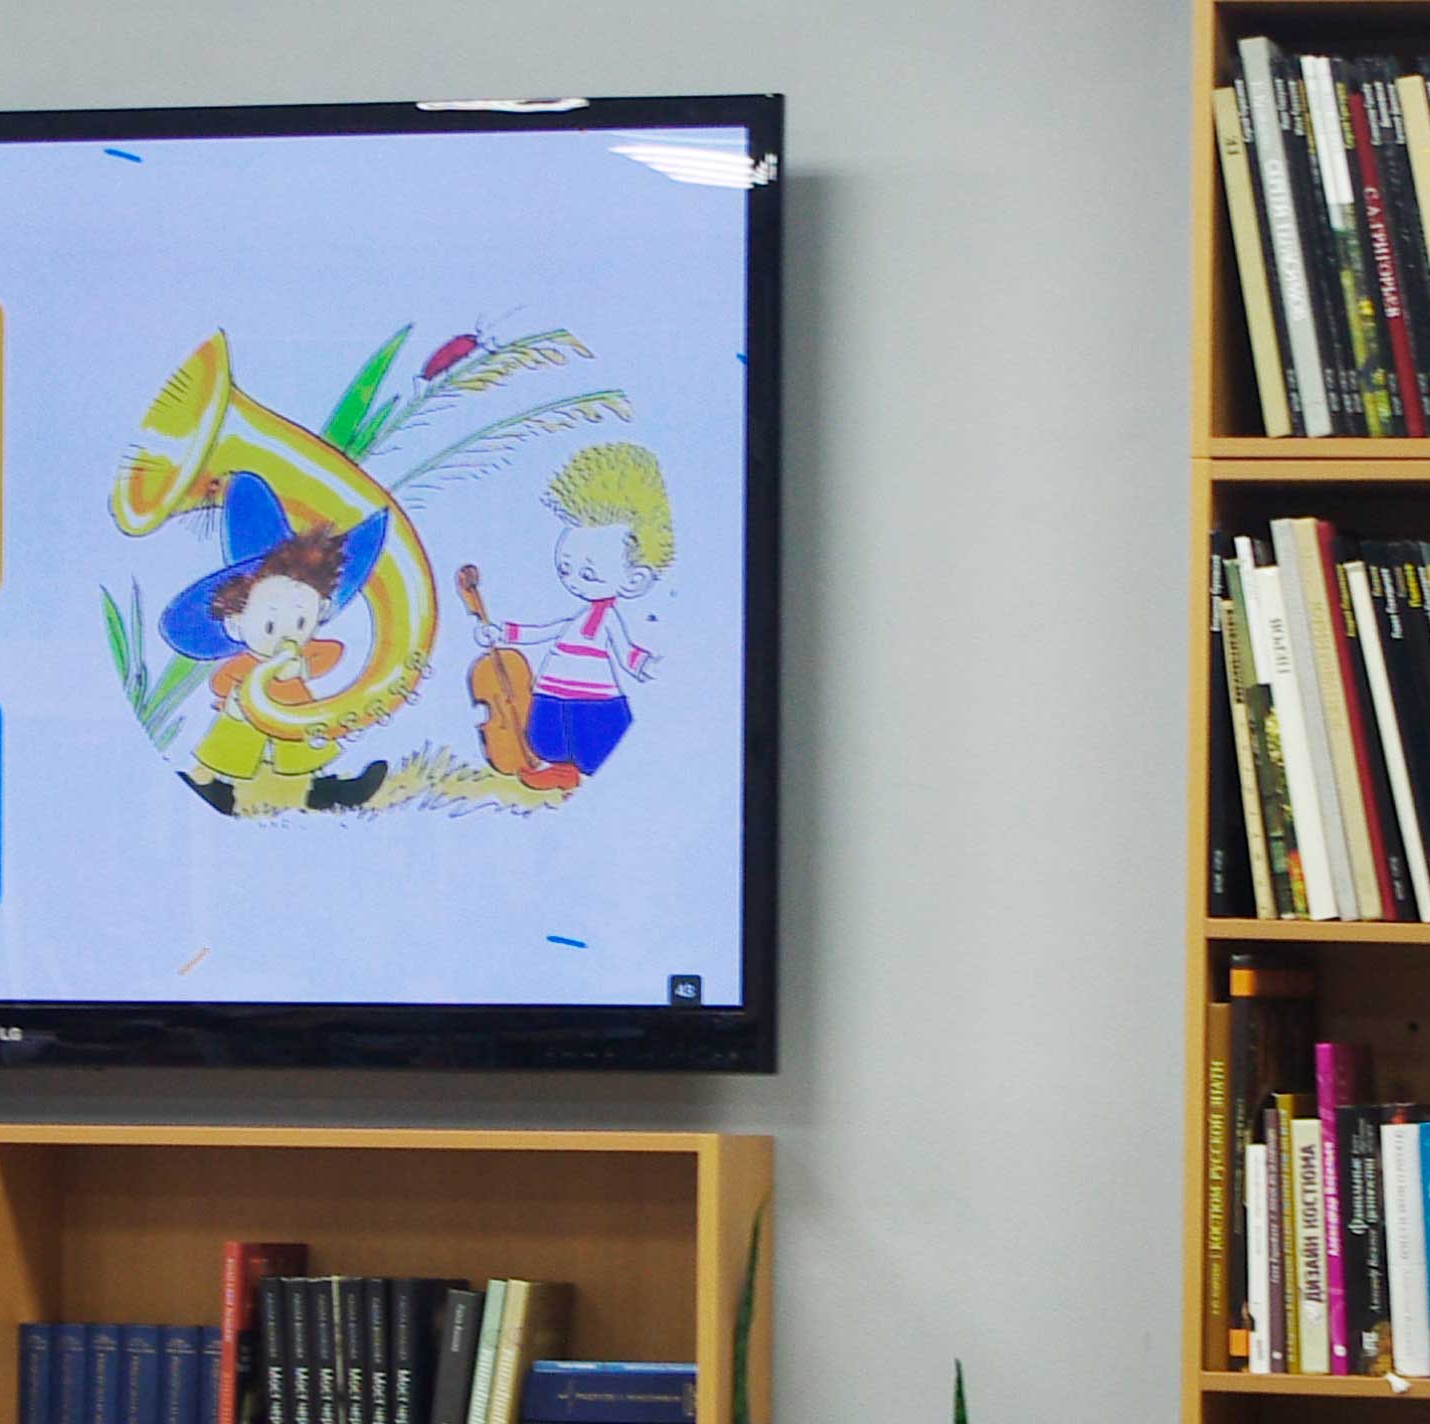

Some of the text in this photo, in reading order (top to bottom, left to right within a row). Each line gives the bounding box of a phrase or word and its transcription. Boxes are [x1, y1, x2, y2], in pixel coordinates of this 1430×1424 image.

[1210, 1114, 1224, 1179] РУССКОЙ
[1209, 1182, 1224, 1250] КОСТЮМ
[1298, 1143, 1323, 1304] ДИЗАЙН КОСТЮМА
[267, 1366, 282, 1399] Мост
[293, 1367, 308, 1399] Мост
[319, 1368, 334, 1400] Мост
[347, 1368, 362, 1400] Мост
[372, 1372, 386, 1404] Мост
[397, 1370, 410, 1402] Мост
